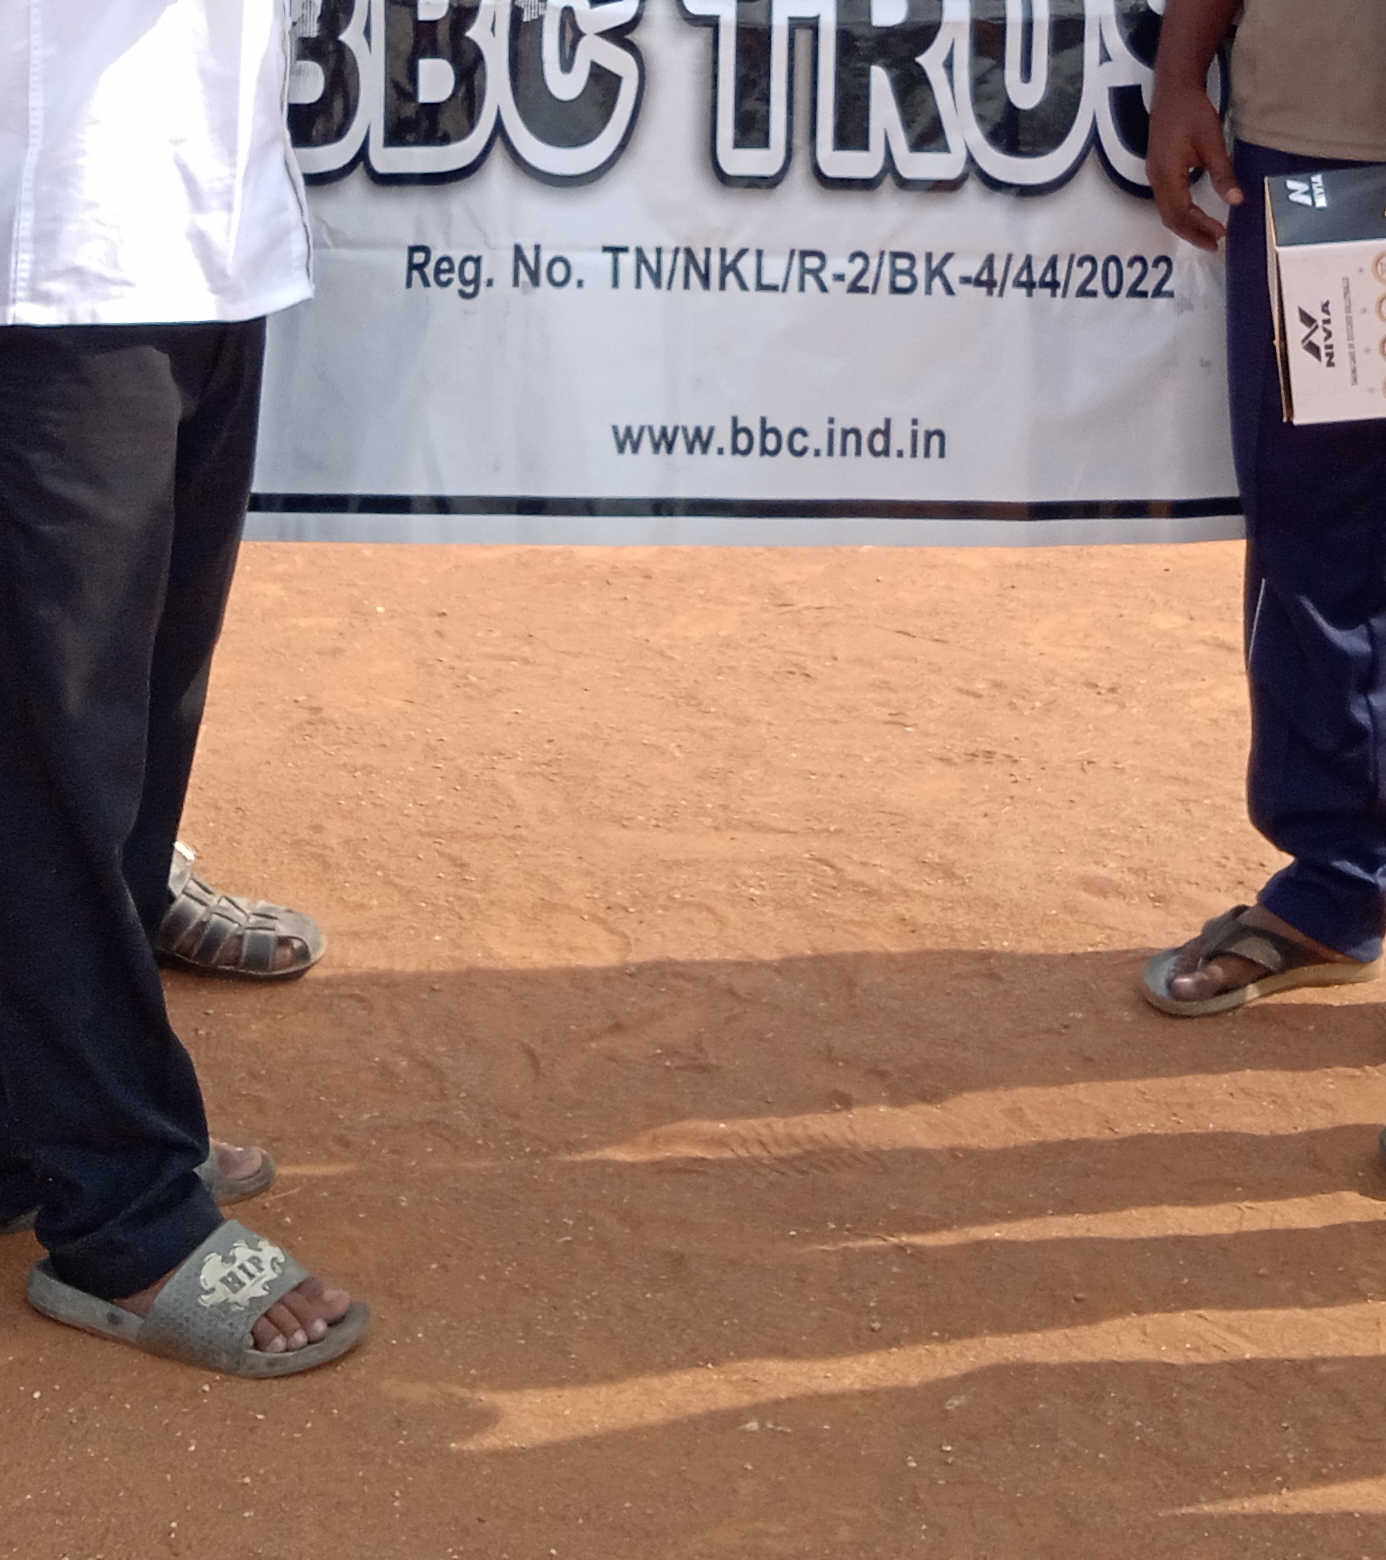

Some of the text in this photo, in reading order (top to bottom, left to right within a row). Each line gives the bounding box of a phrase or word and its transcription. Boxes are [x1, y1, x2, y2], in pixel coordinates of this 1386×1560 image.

[405, 242, 1175, 300] Reg. No. TN/NKL/R-2/BK-4/44/2022
[1320, 299, 1336, 368] NIVIA
[611, 415, 948, 459] www.bbc.ind.in
